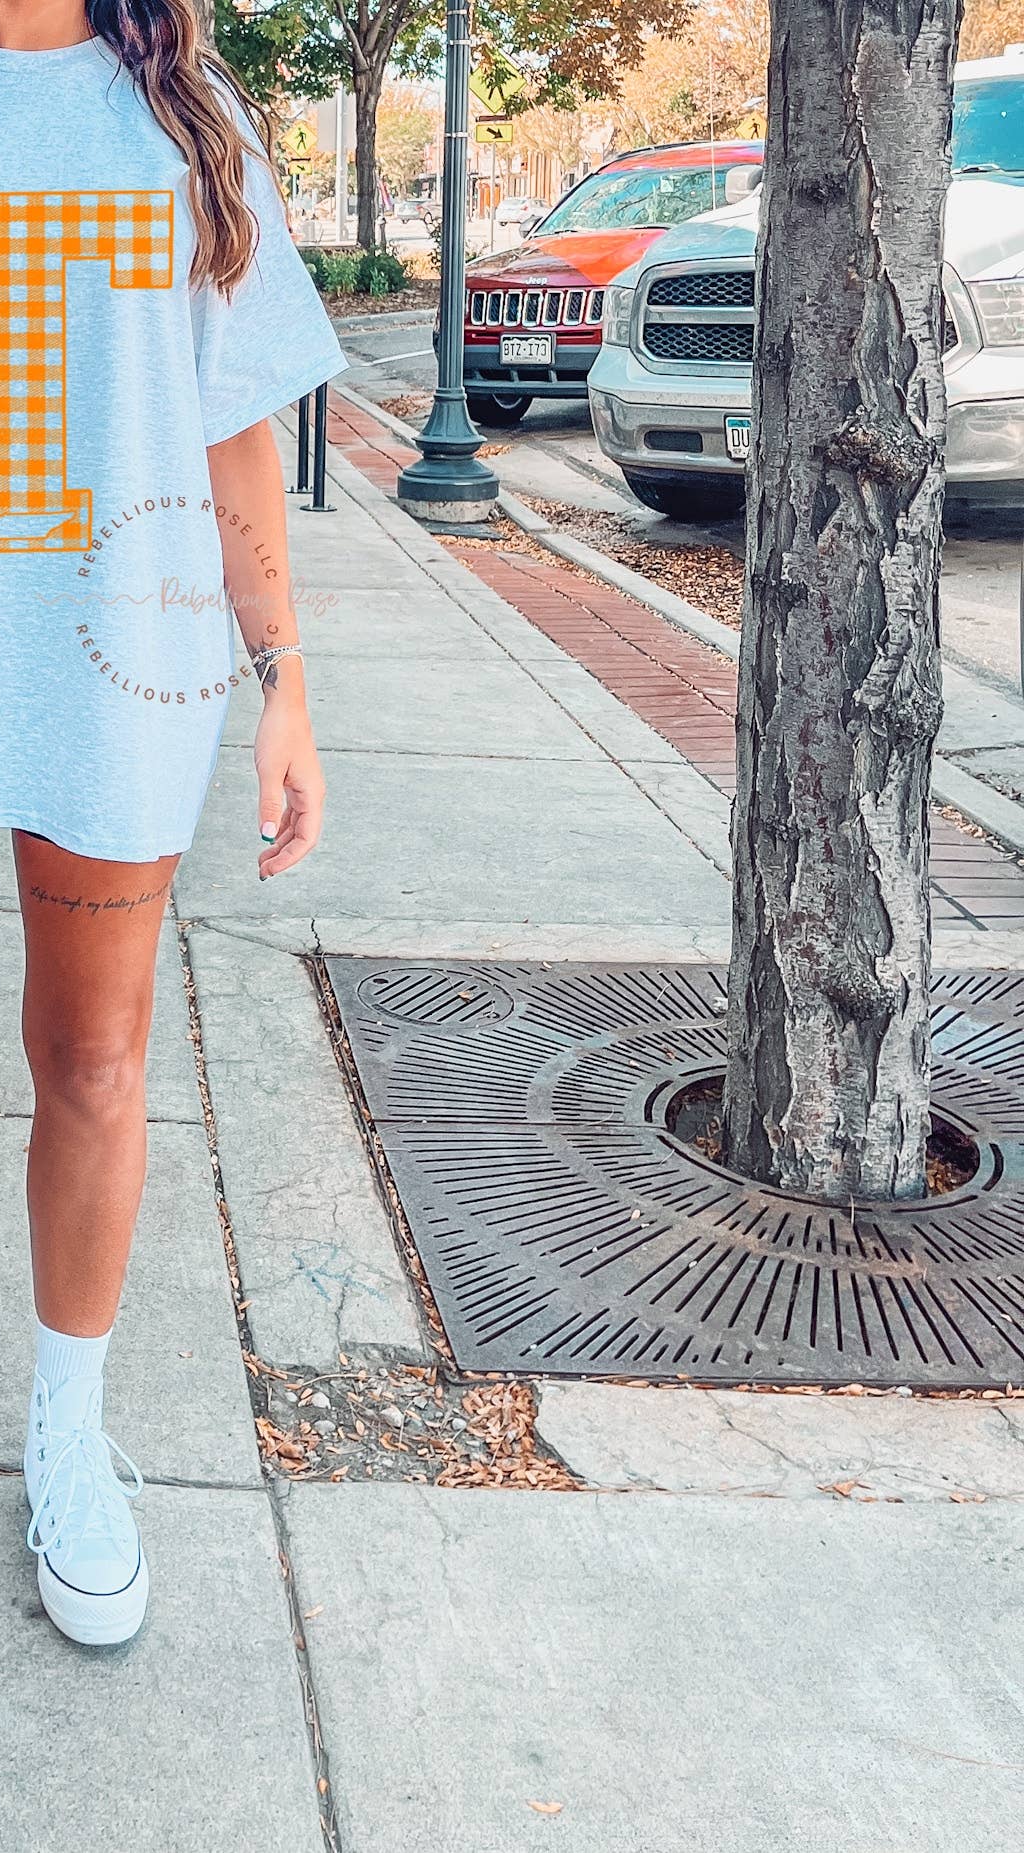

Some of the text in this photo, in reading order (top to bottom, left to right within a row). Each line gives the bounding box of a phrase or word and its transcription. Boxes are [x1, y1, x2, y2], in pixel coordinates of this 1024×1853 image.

[525, 276, 548, 285] Jeep
[731, 428, 750, 447] DU
[88, 902, 102, 916] my
